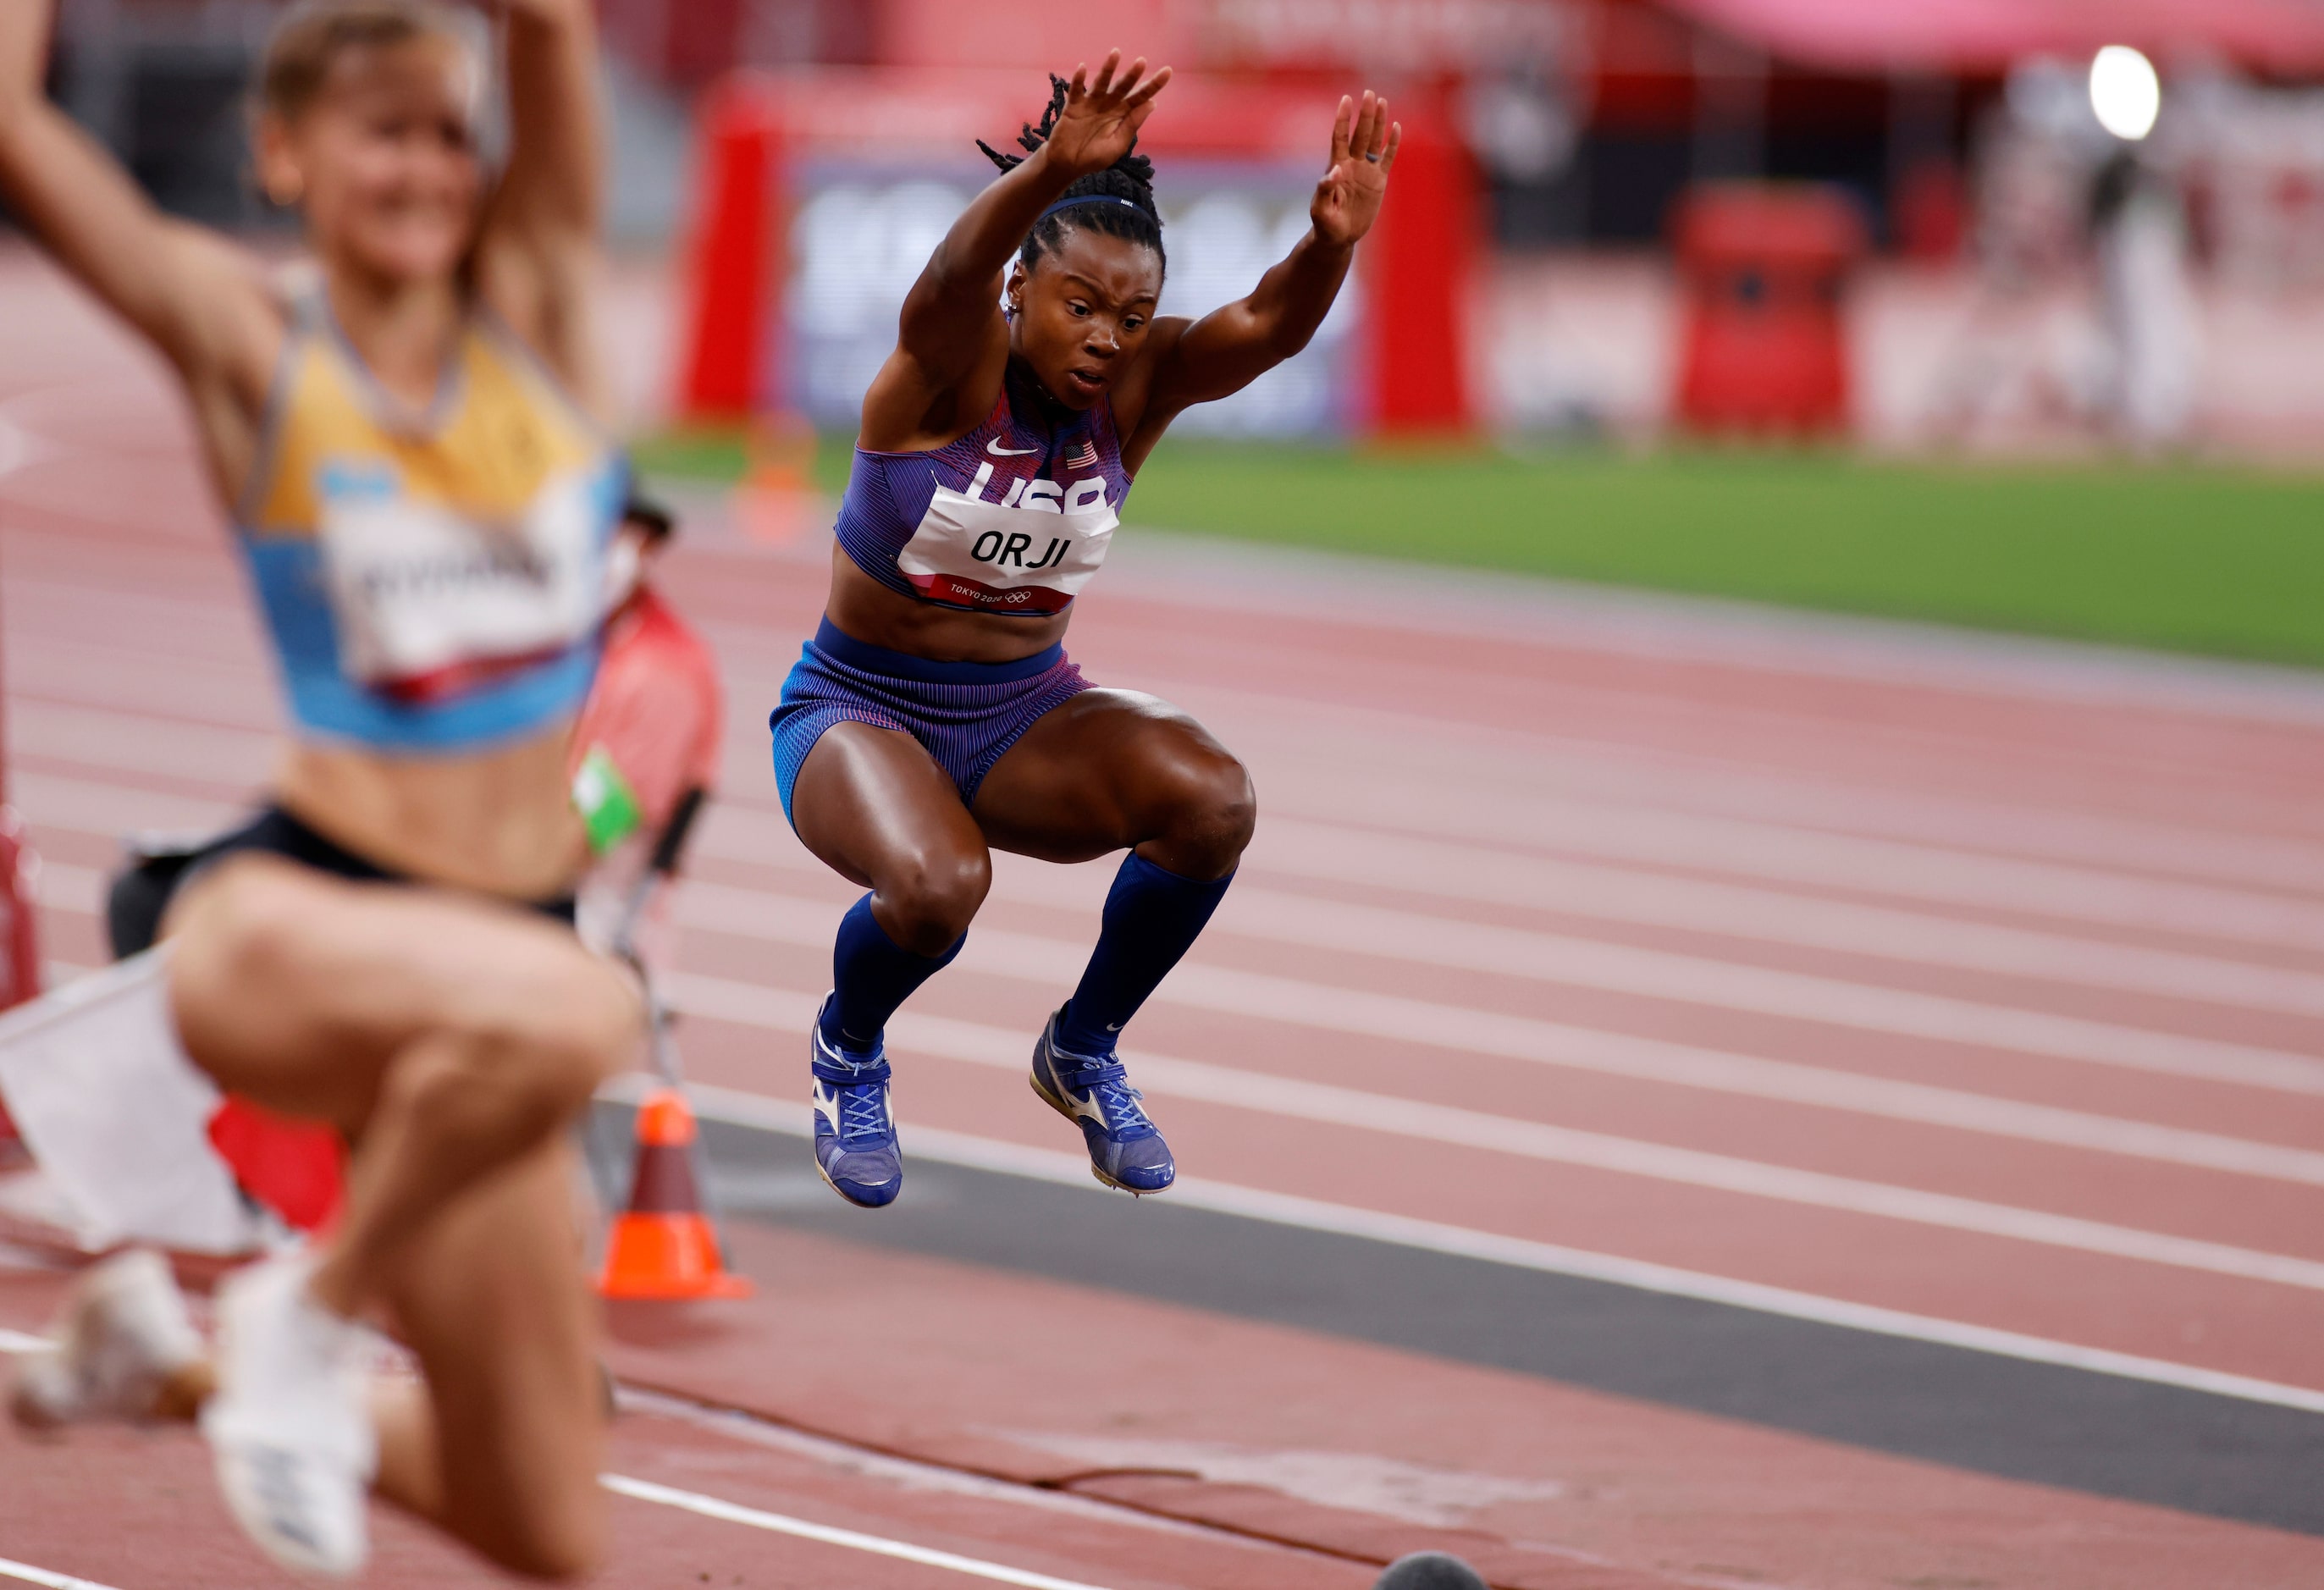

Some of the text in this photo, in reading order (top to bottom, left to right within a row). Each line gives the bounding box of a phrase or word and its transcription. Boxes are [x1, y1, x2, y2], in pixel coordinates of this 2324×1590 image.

[970, 530, 1072, 569] ORJI
[951, 583, 1002, 603] TOKYO 2020
